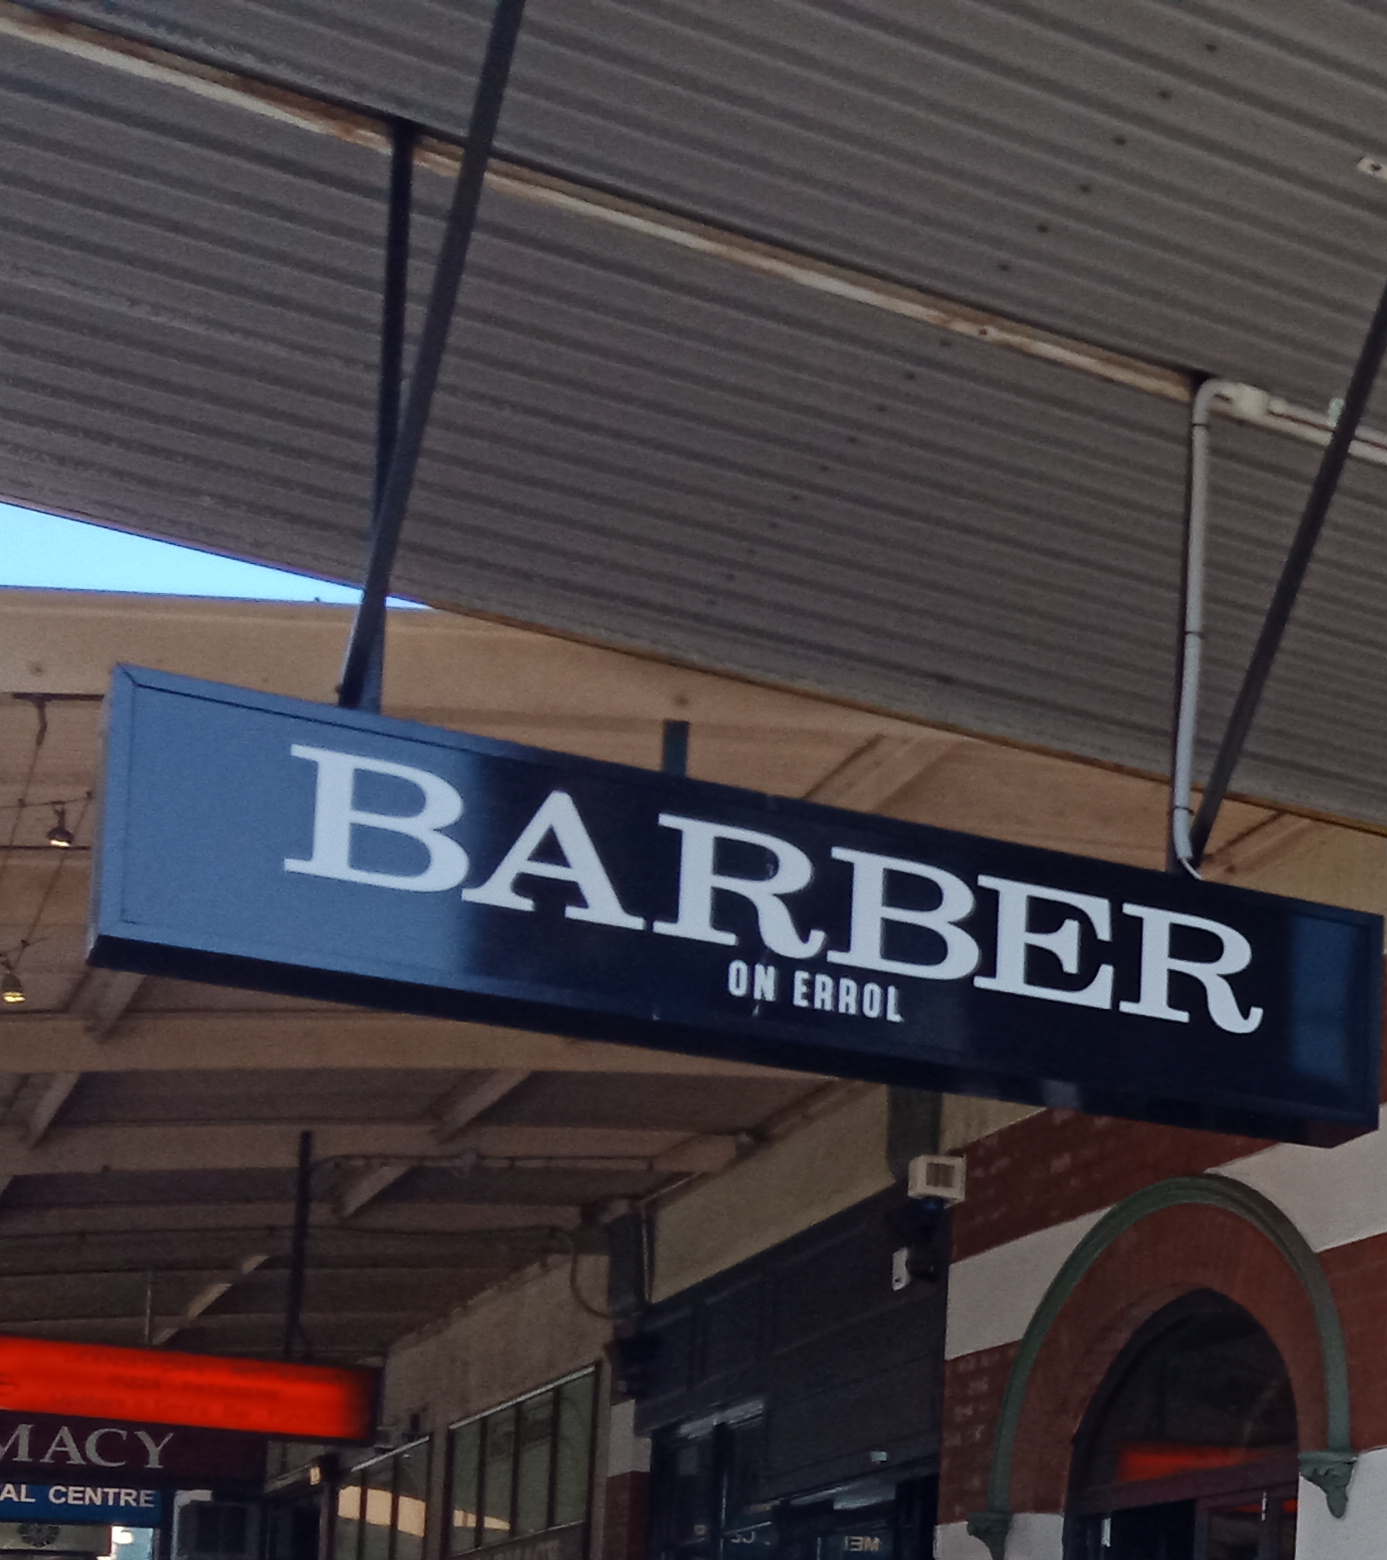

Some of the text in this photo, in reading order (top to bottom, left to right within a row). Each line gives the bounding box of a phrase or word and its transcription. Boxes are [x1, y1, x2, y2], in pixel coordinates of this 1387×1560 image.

[283, 743, 1264, 1034] BARBER
[728, 961, 904, 1023] ON ERROL
[48, 1485, 156, 1508] CENTRE
